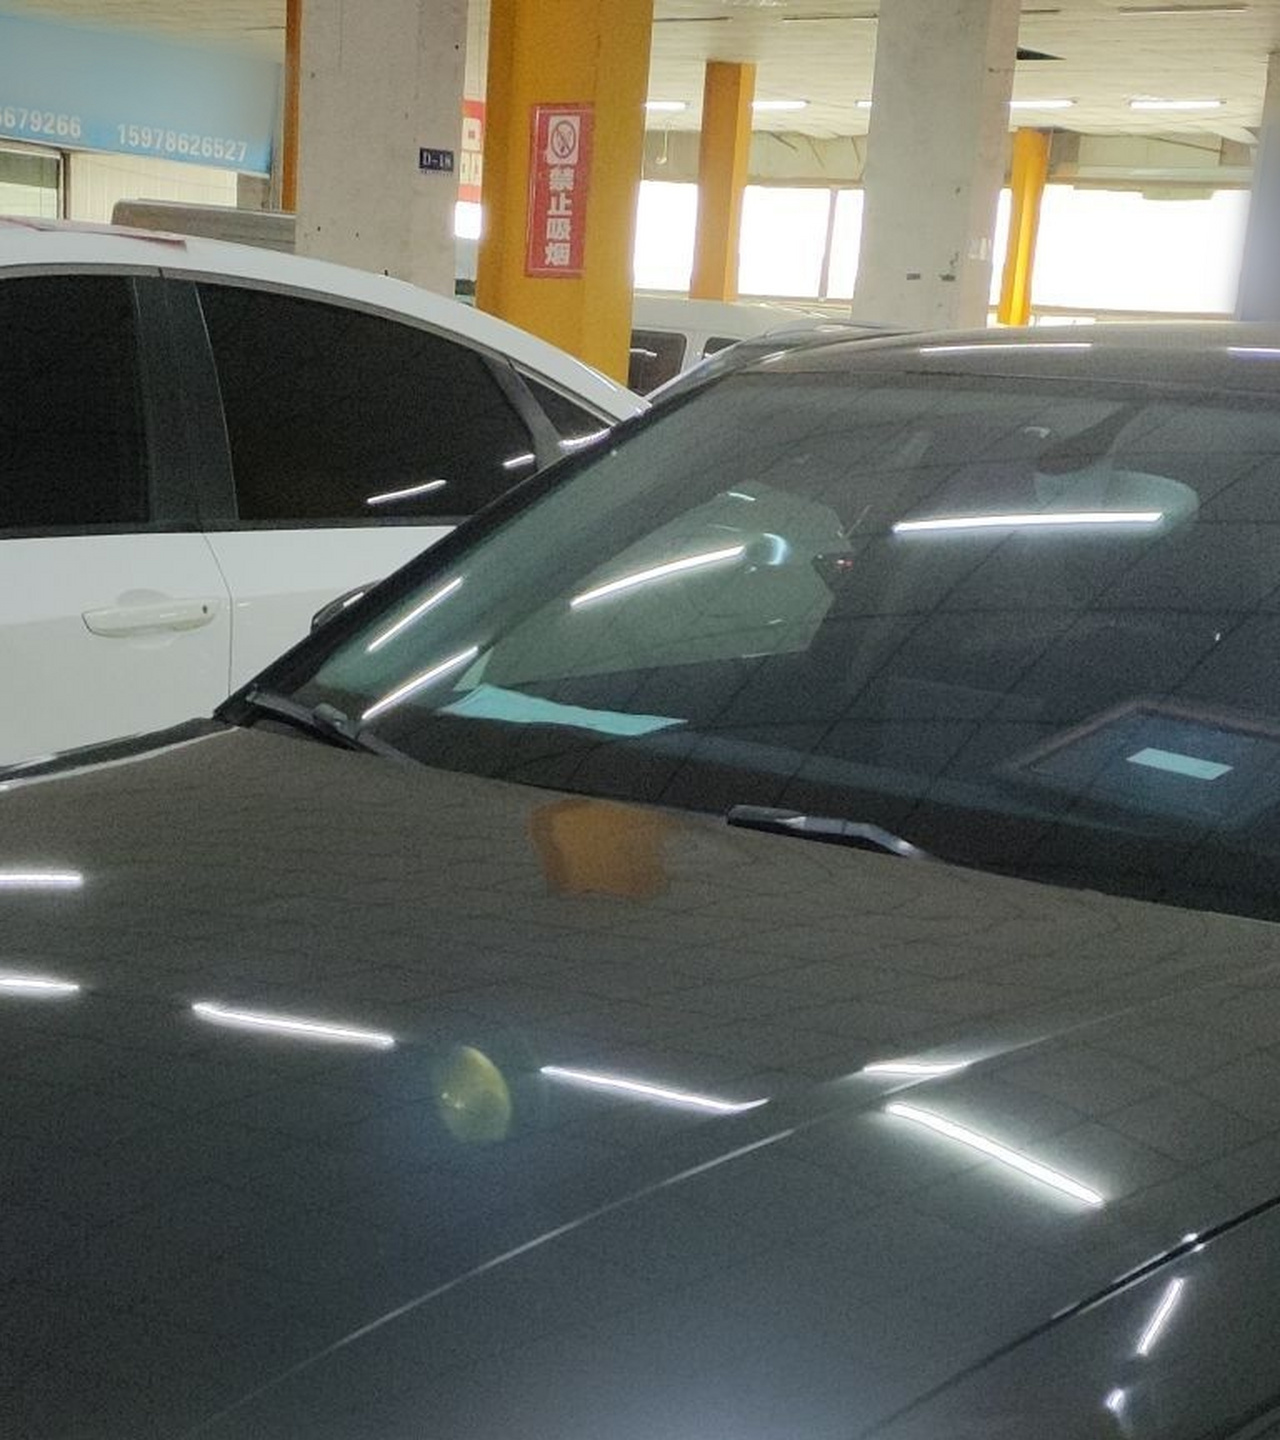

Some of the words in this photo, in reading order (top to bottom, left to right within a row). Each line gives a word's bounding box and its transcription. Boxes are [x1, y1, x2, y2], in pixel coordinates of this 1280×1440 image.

[118, 124, 248, 161] 15978626527
[544, 166, 575, 266] 禁止吸烟
